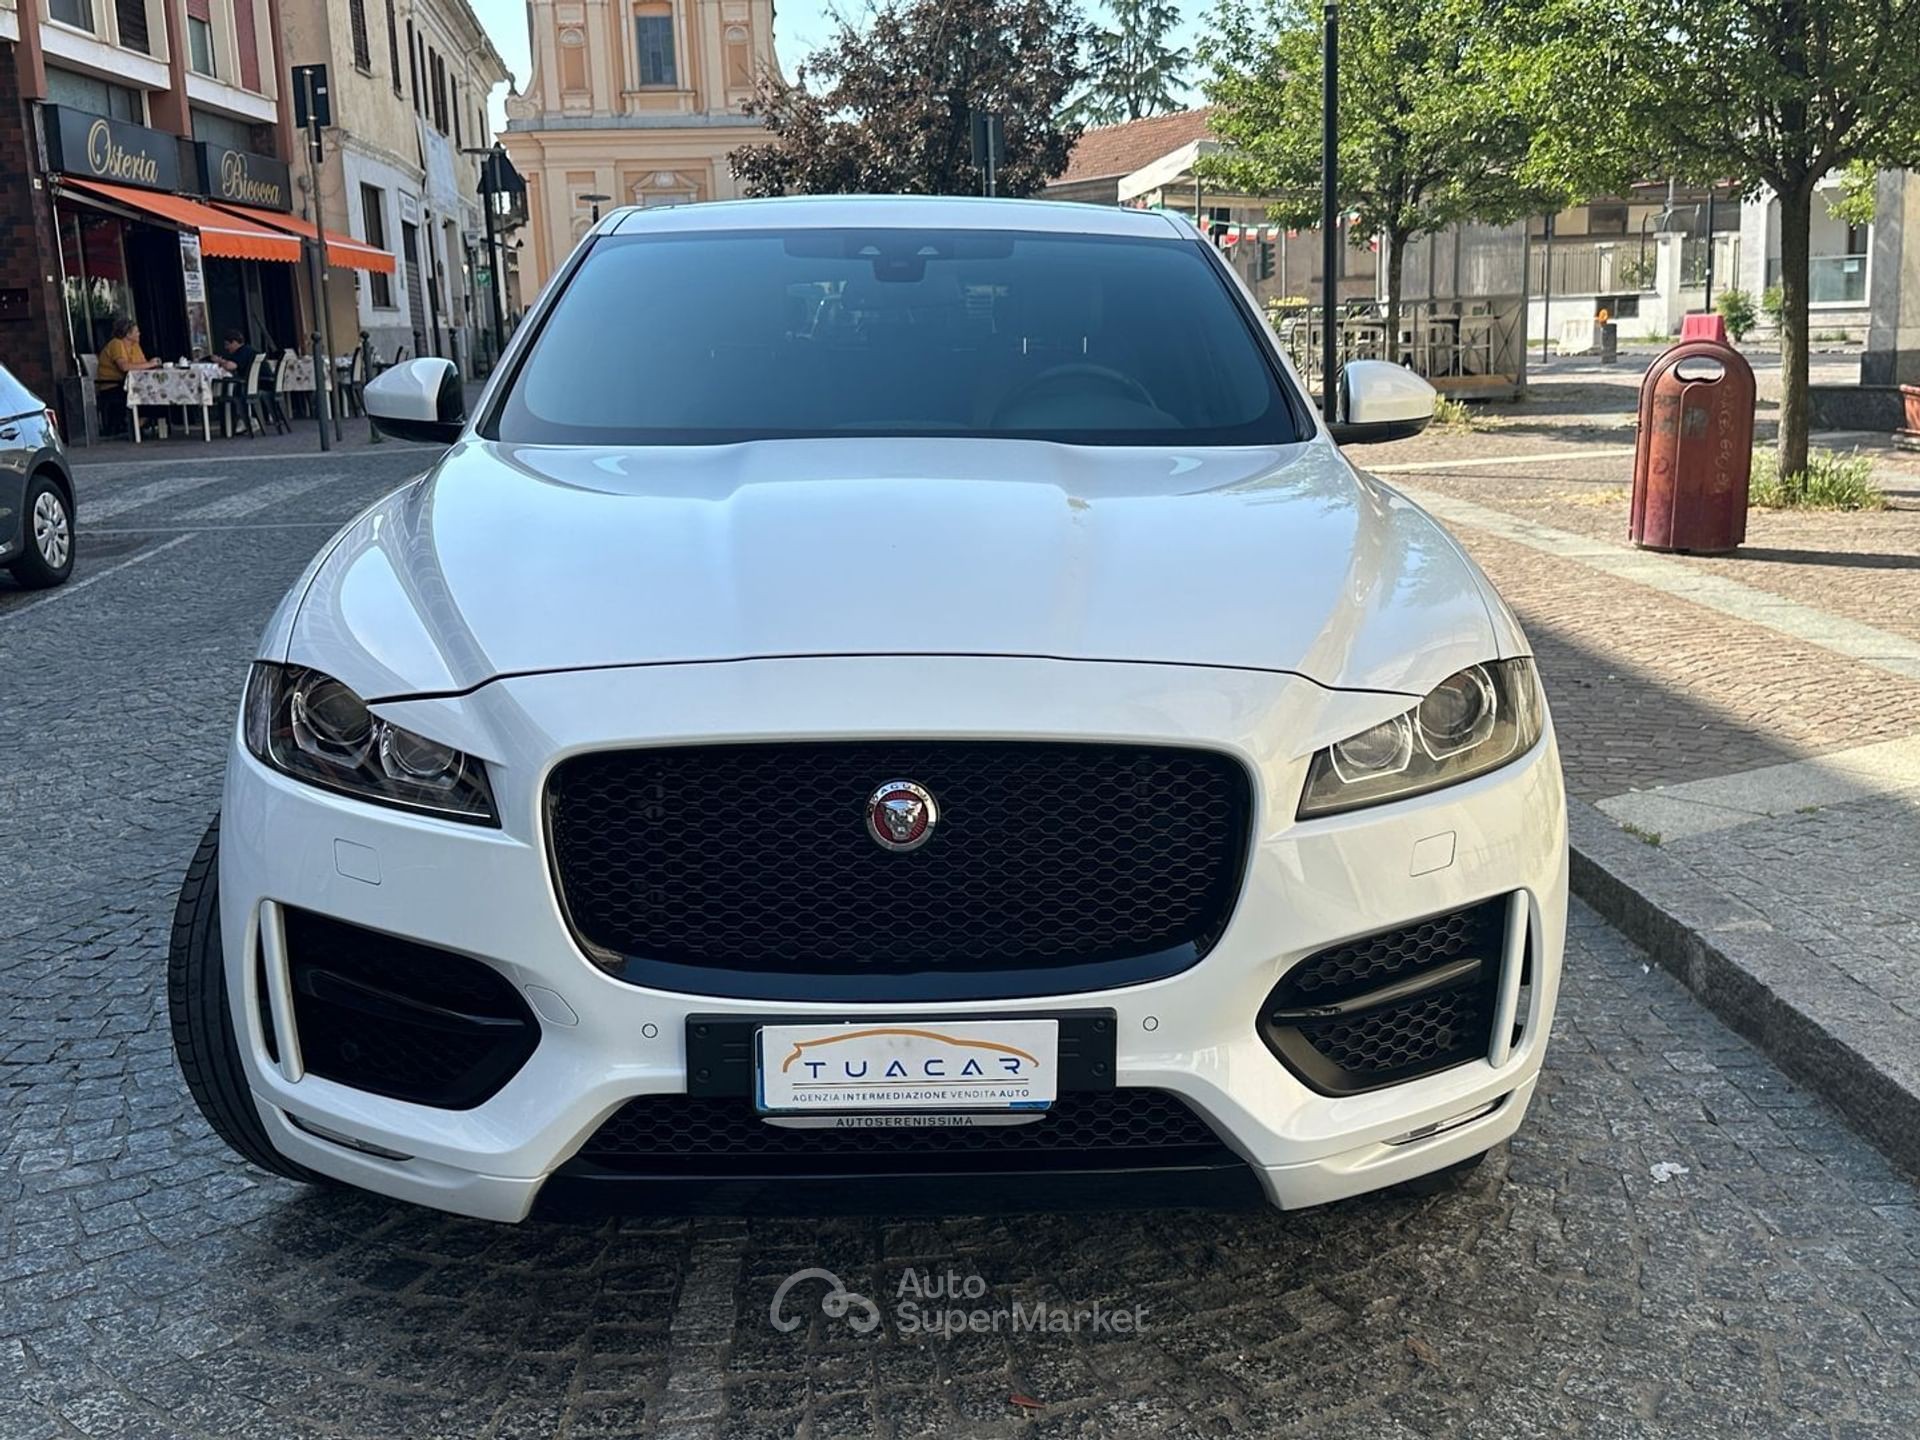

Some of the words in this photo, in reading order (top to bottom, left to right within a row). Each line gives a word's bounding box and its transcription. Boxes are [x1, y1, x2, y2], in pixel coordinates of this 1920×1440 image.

[88, 119, 158, 184] Osteria
[221, 150, 282, 206] Bicocca
[804, 1058, 1022, 1079] TUACAR
[792, 1092, 840, 1102] AGENZIA
[842, 1090, 948, 1101] INTERMEDIAZIONE
[950, 1089, 997, 1099] VENDITA
[999, 1088, 1030, 1098] AUTO
[836, 1115, 974, 1128] AUTOSERENISSIMA
